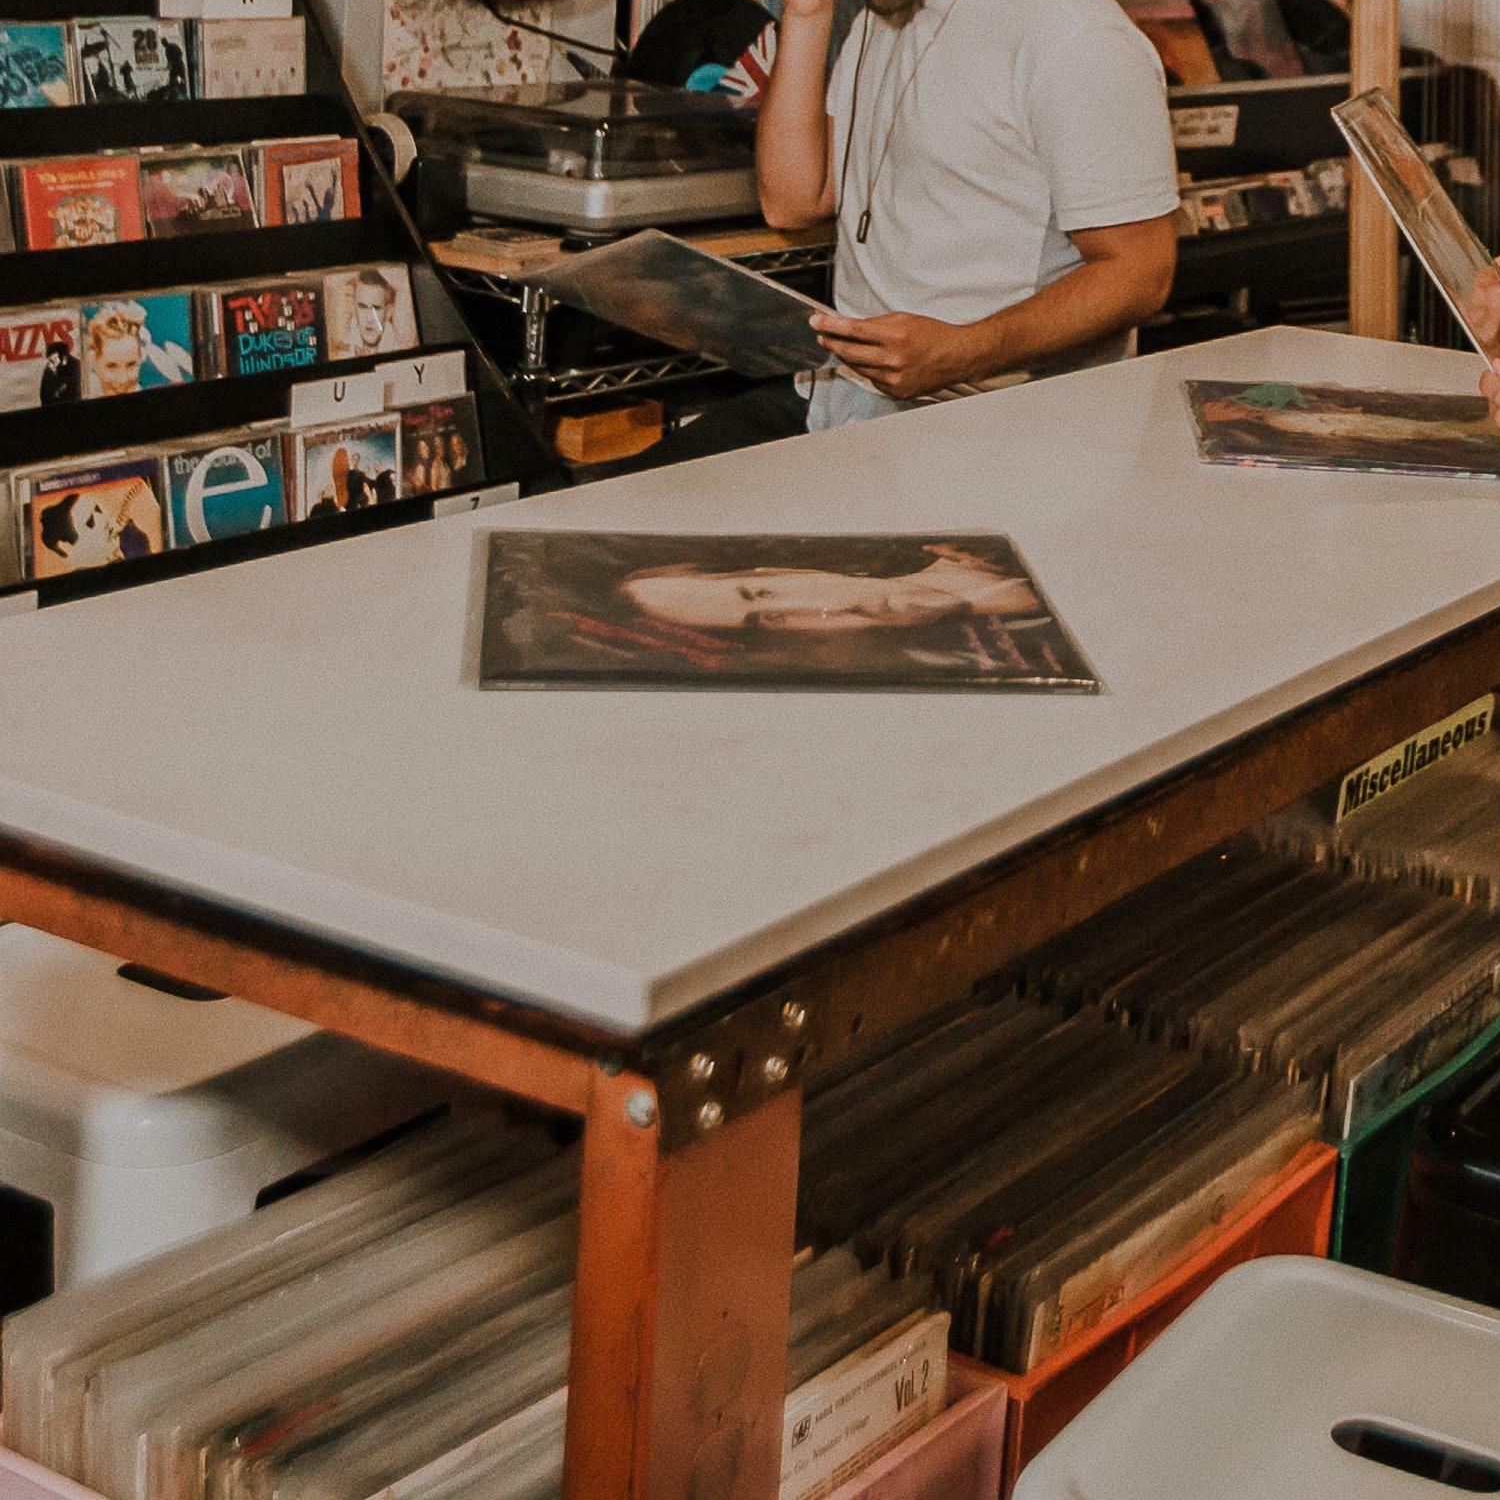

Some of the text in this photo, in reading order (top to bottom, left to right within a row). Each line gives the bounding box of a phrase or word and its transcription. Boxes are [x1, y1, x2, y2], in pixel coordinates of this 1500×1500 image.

[414, 363, 425, 385] Y
[333, 381, 347, 402] U
[173, 454, 199, 476] the
[255, 438, 273, 460] of
[1342, 710, 1489, 818] Miscellaneous
